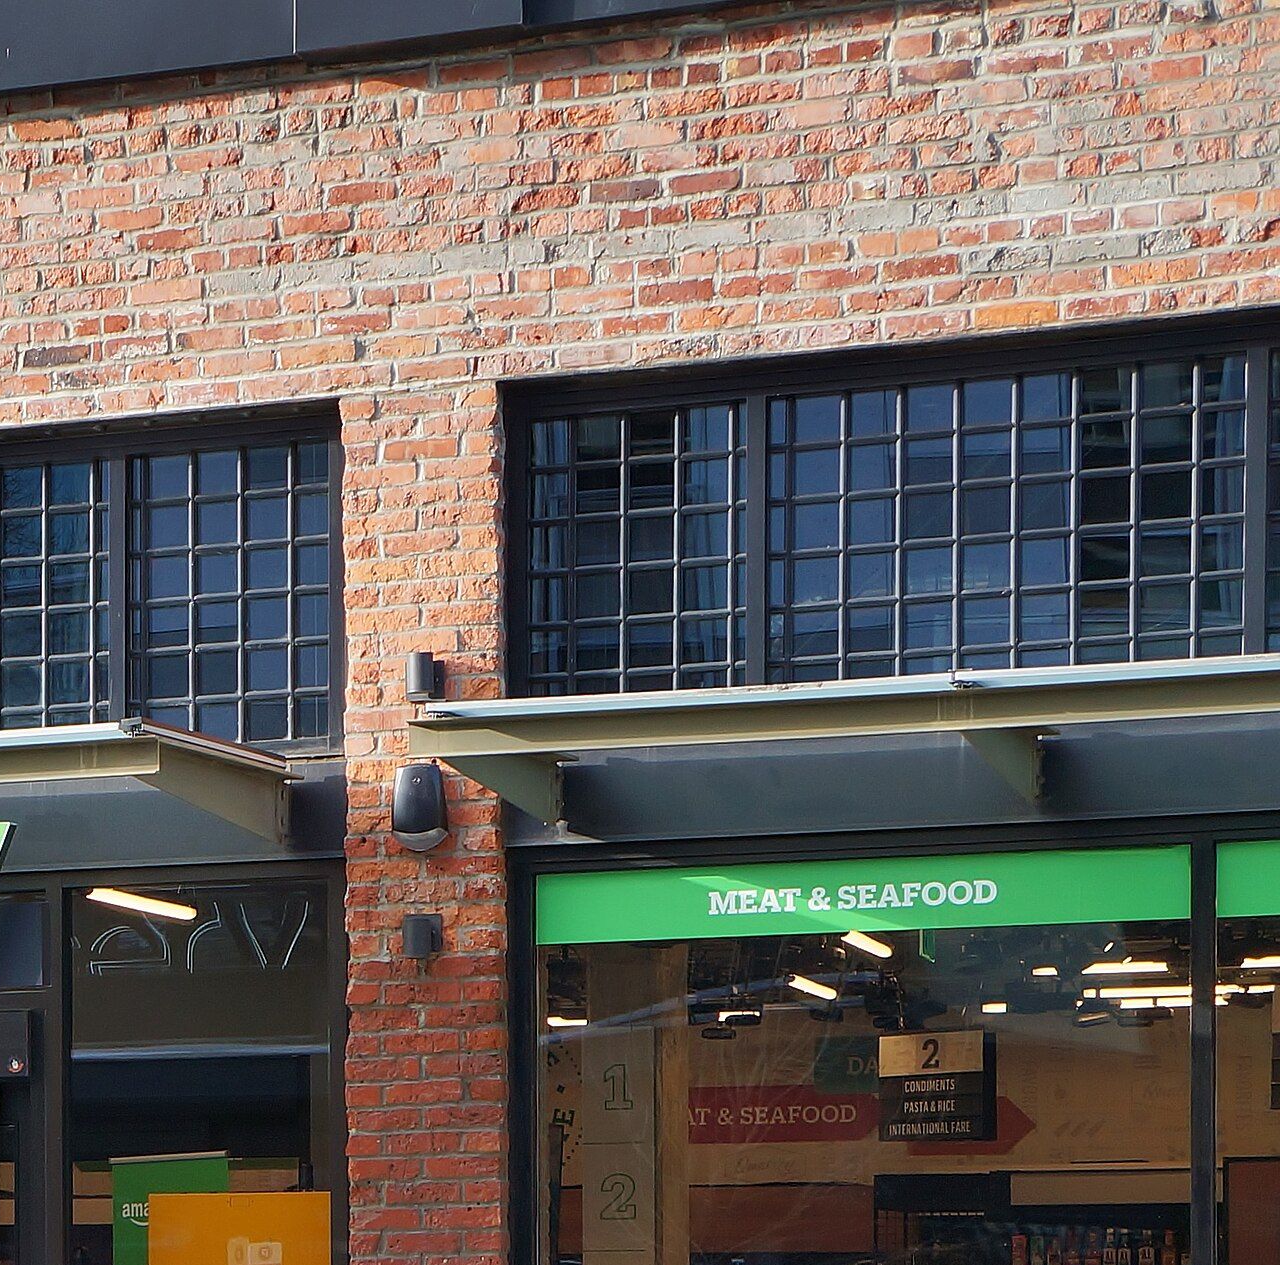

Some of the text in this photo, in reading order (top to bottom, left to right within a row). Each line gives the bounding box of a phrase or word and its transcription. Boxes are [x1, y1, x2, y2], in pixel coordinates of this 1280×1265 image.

[708, 880, 998, 915] MEAT & SEAFOOD
[921, 1038, 940, 1070] 2
[603, 1063, 634, 1111] 1
[904, 1079, 955, 1093] CONDIMENTS
[717, 1106, 733, 1125] &
[740, 1104, 857, 1125] SEAFOOD
[904, 1100, 956, 1113] PASTA & RICE
[889, 1121, 971, 1136] INTERNATIONAL FARE
[600, 1173, 637, 1220] 2
